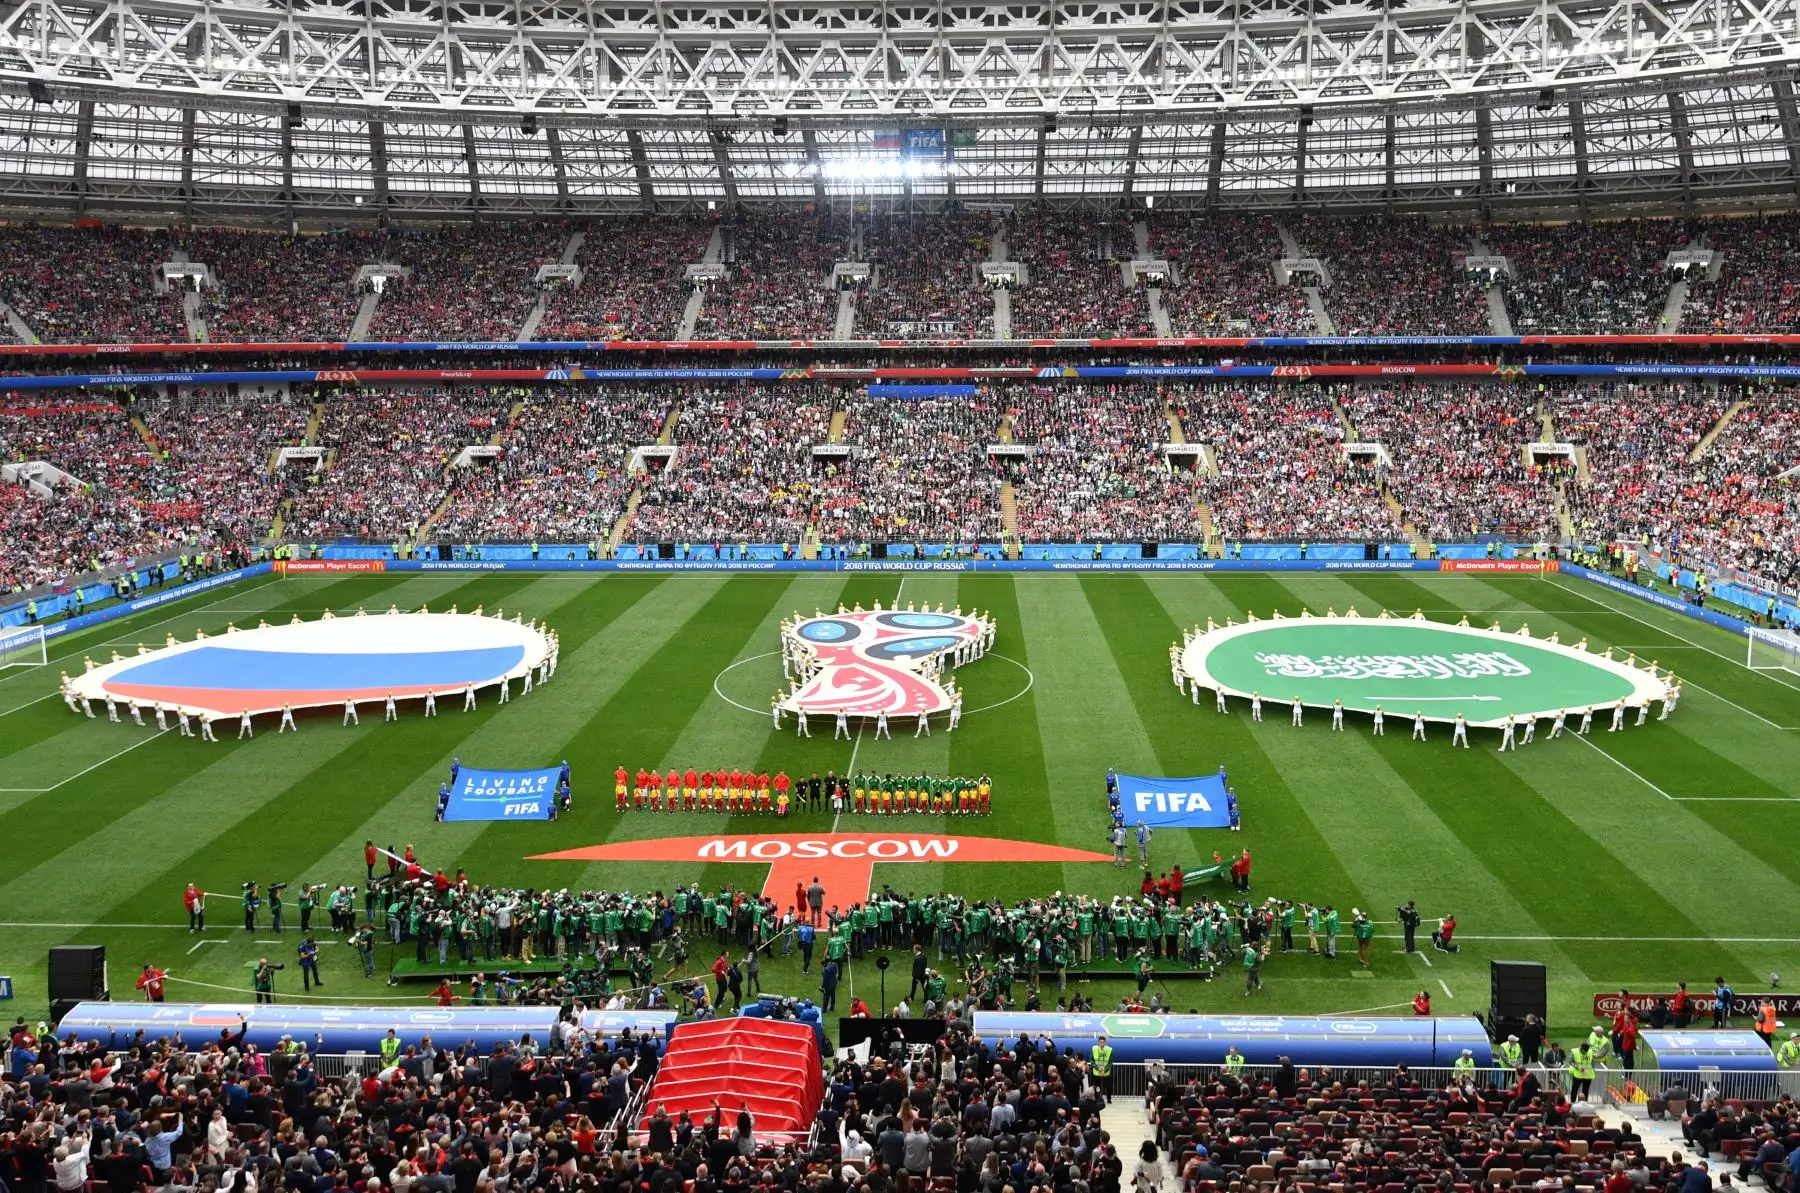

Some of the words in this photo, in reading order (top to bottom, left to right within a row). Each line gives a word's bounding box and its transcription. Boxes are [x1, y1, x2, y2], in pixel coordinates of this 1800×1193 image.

[910, 136, 938, 148] FIFA
[844, 562, 863, 570] 2018
[864, 562, 882, 570] FIFA
[883, 562, 914, 570] WORLD
[914, 562, 932, 570] CUP
[466, 776, 548, 788] LIVING
[464, 785, 544, 796] FOOTBALL
[1135, 792, 1213, 812] FIFA
[504, 802, 540, 816] FIFA
[698, 840, 959, 858] MOSCOW
